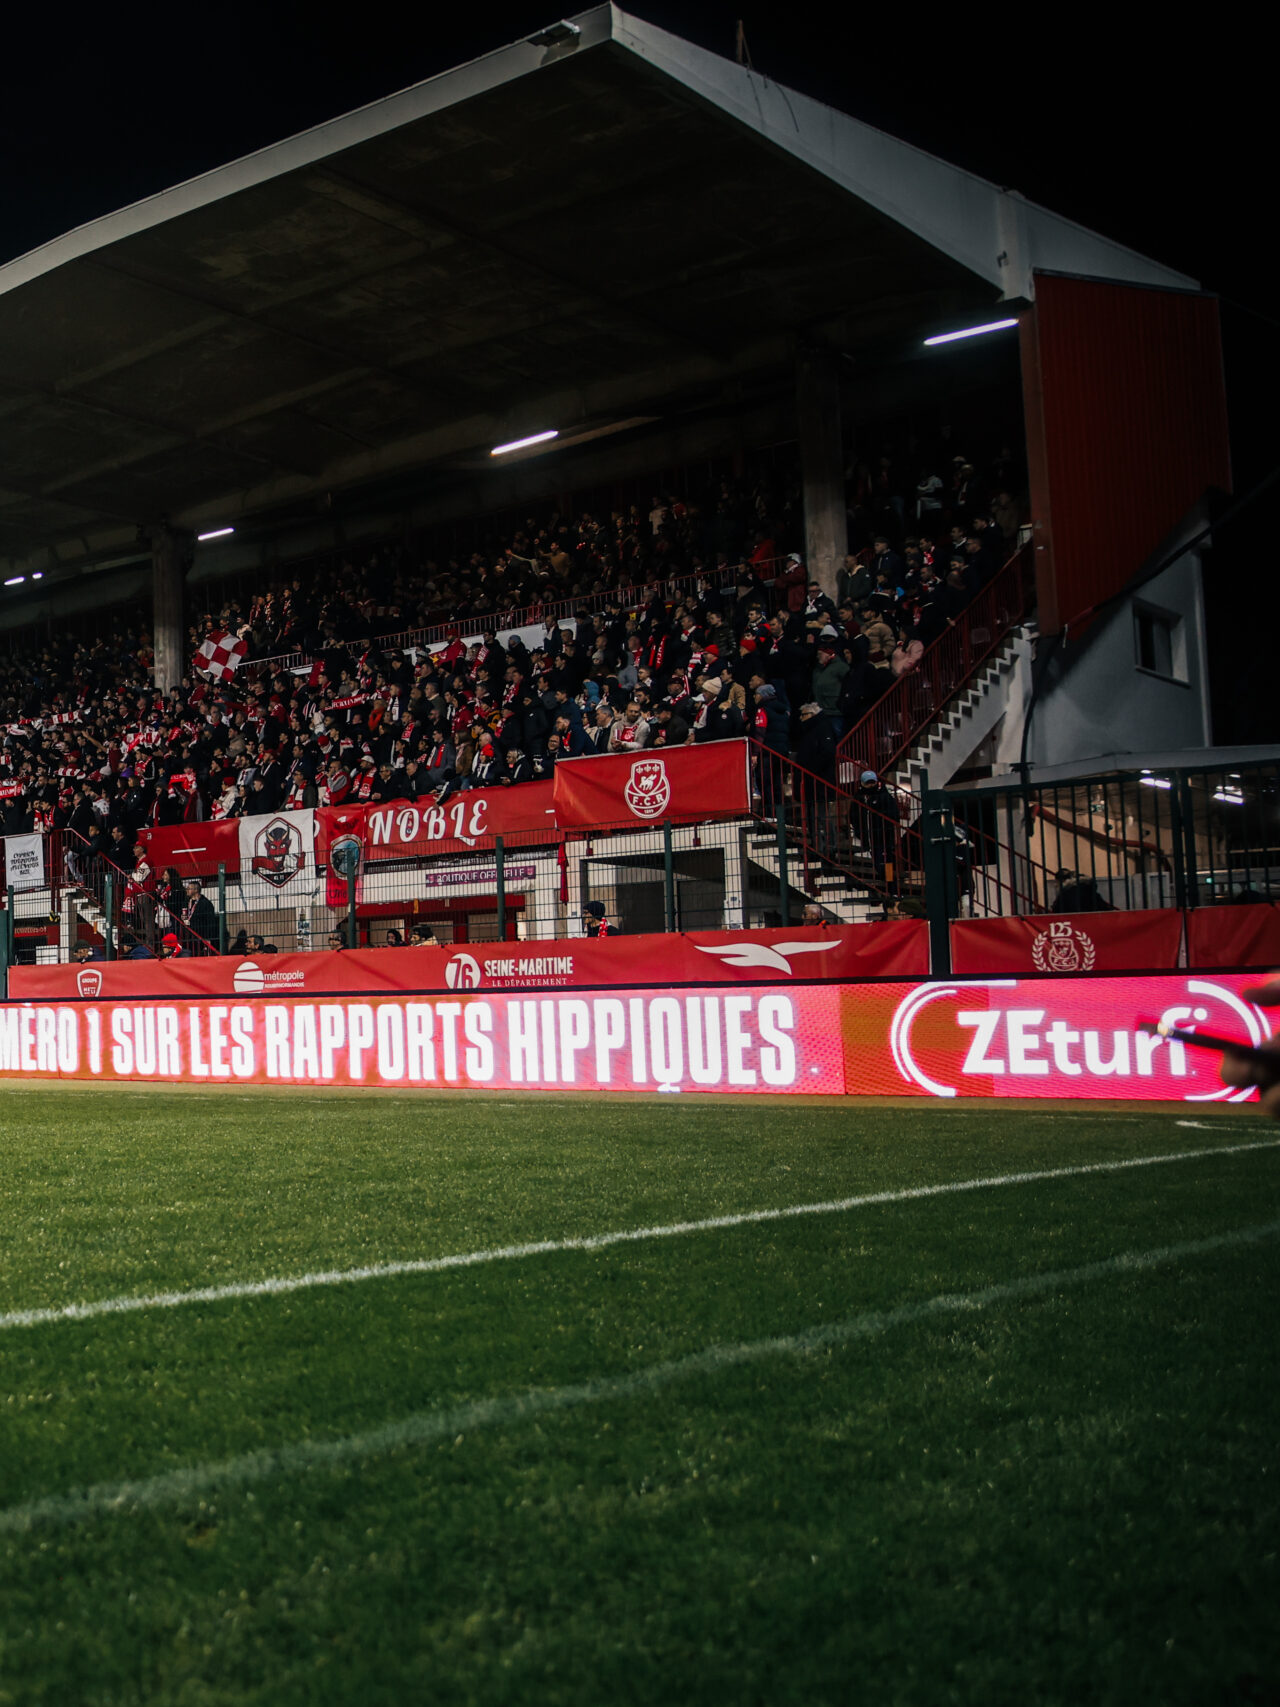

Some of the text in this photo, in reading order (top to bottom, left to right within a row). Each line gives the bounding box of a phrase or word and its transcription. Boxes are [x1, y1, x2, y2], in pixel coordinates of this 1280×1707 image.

[480, 868, 525, 881] OFFIELLE
[1050, 922, 1072, 938] 125
[264, 969, 304, 982] métropole
[484, 956, 573, 977] SEINE-MARITIME
[85, 1008, 100, 1074] 1
[111, 1006, 181, 1076] SUR
[190, 1004, 255, 1078] LES
[266, 1000, 494, 1082] RAPPORTS
[507, 995, 796, 1092] HIPPIQUES
[957, 1006, 1208, 1076] ZEturf
